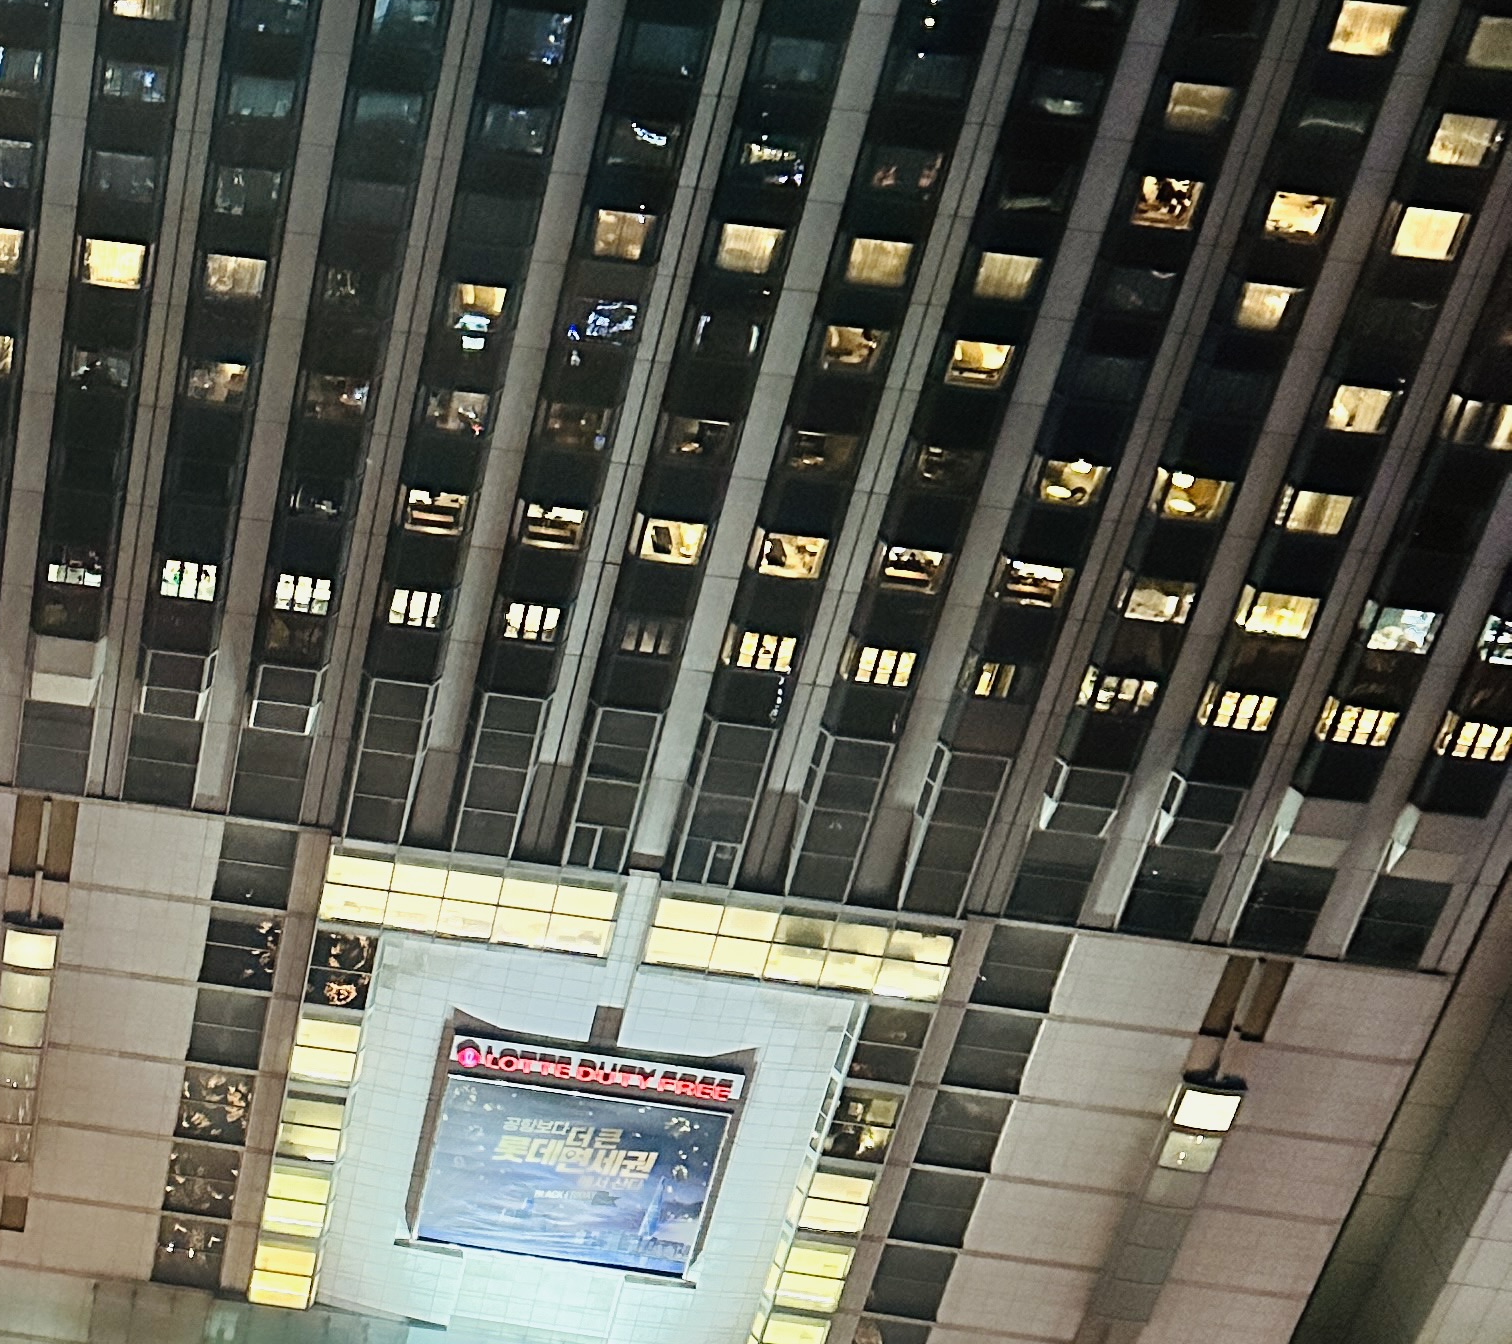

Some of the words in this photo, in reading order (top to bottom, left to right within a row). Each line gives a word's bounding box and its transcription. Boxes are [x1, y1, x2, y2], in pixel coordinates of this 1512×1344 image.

[484, 1052, 570, 1080] LOTTE
[575, 1064, 653, 1090] DUTY
[656, 1077, 731, 1102] FREE
[502, 1116, 572, 1136] 공항보다
[565, 1126, 595, 1148] 더
[593, 1127, 624, 1150] 큰
